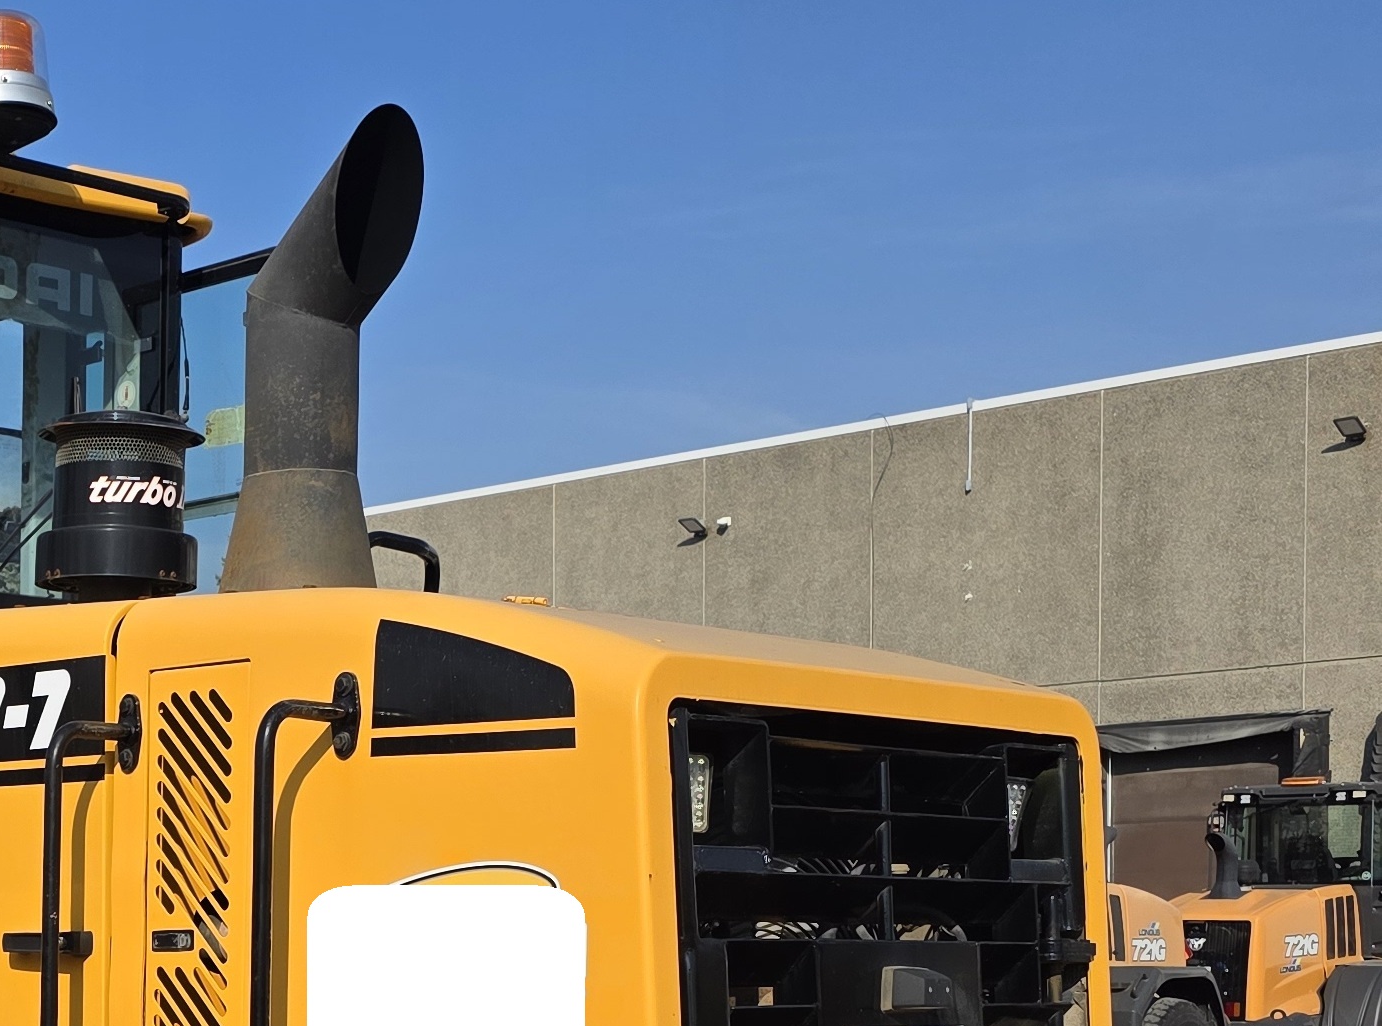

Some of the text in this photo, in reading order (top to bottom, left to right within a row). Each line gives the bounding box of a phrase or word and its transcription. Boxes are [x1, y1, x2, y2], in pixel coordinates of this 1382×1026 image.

[88, 476, 177, 508] turbo
[1131, 938, 1166, 962] 721G
[1284, 933, 1320, 958] 721G
